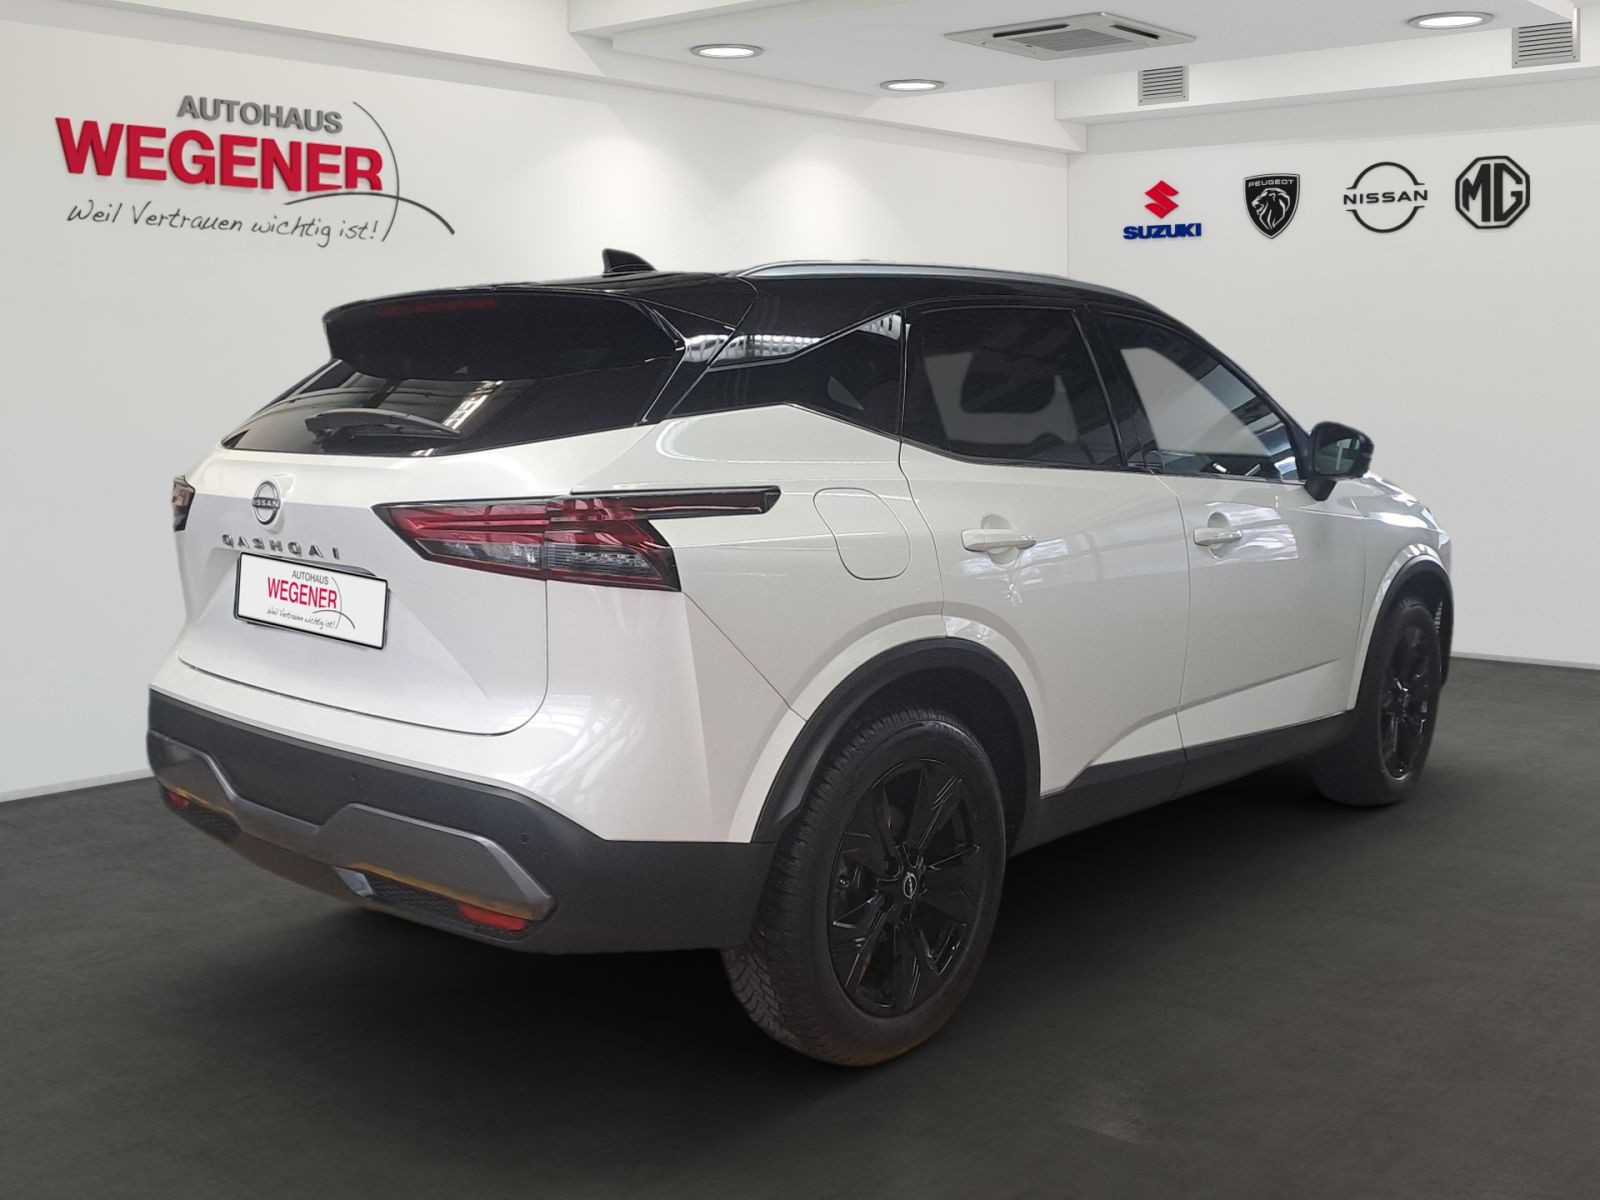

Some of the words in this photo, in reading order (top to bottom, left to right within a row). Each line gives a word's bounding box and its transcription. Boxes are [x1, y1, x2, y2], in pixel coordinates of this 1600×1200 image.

[177, 95, 343, 133] AUTOHAUS
[55, 117, 383, 192] WEGENER
[1248, 178, 1295, 188] PEUGEOT
[1343, 188, 1428, 206] NISSAN
[1461, 162, 1524, 223] MG
[66, 199, 123, 223] Weil
[132, 200, 243, 231] Vertrauen
[251, 210, 331, 248] wichtig
[339, 215, 378, 240] ist!
[1122, 222, 1202, 240] SUZUKI
[222, 534, 341, 561] QASHQAI
[291, 569, 329, 586] AUTOHAUS
[267, 577, 338, 610] WEGENER
